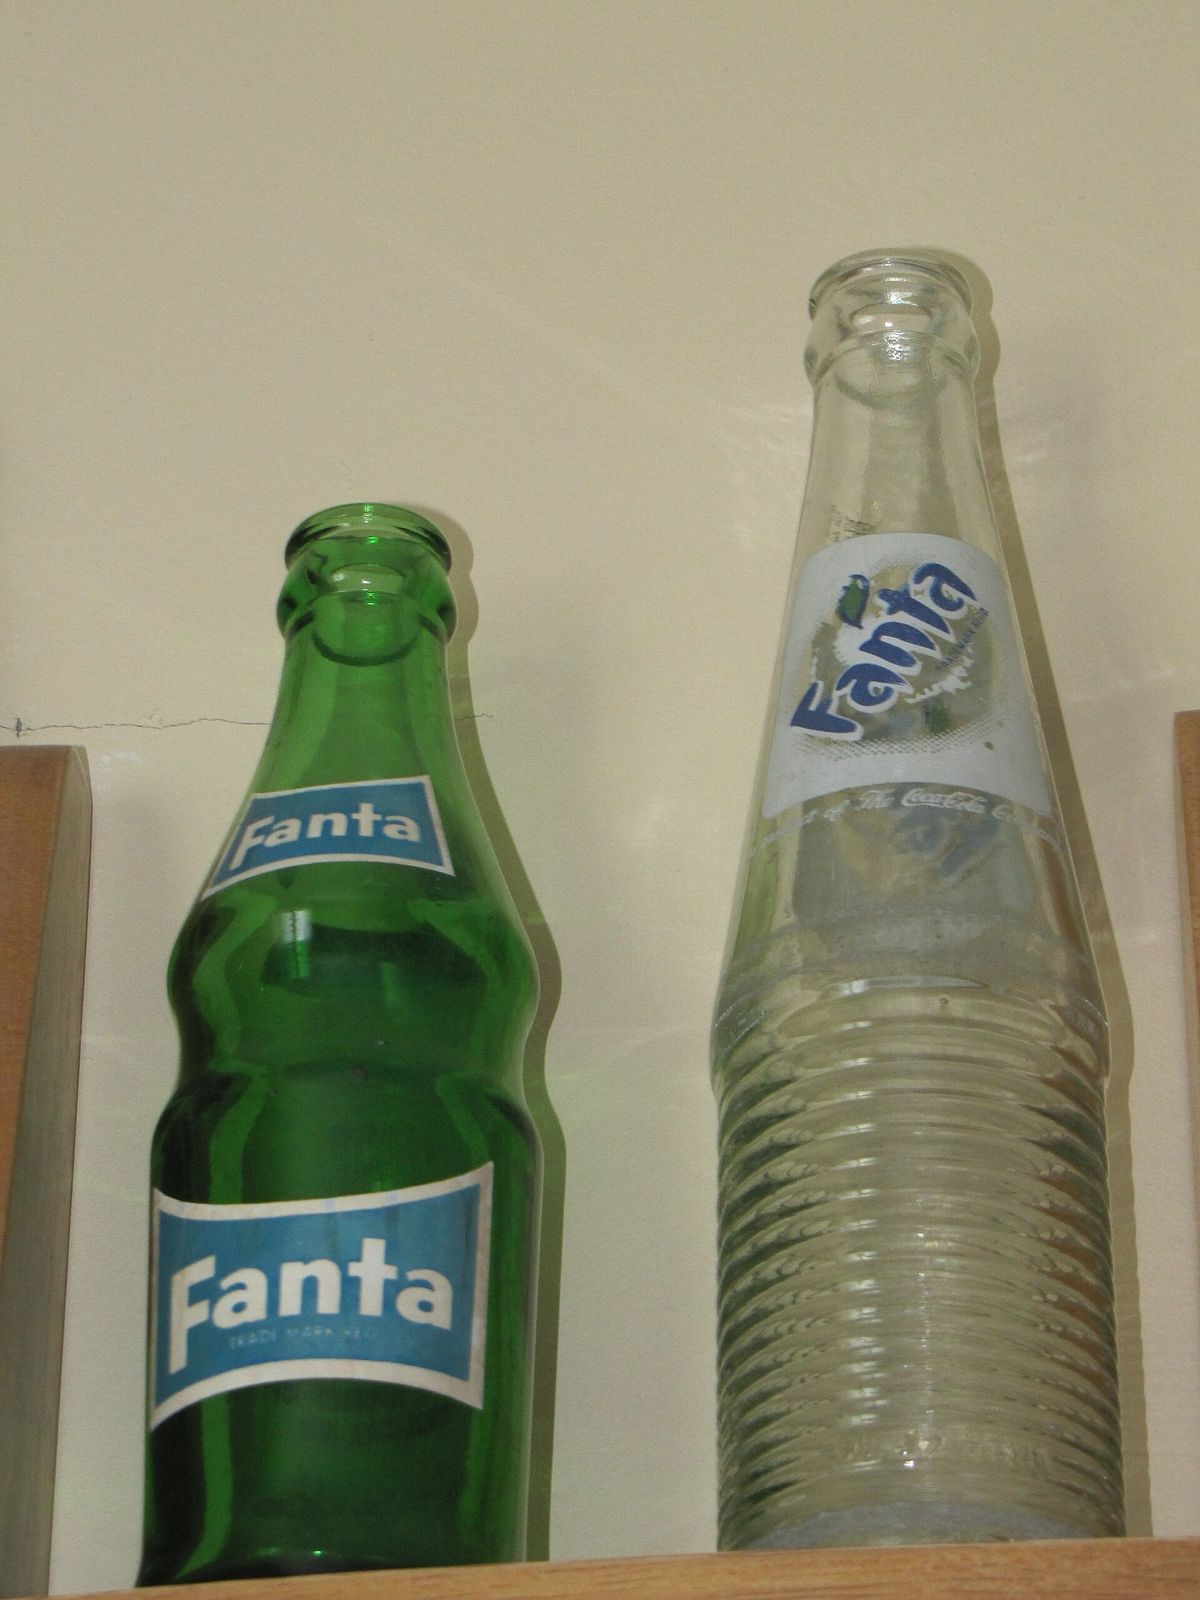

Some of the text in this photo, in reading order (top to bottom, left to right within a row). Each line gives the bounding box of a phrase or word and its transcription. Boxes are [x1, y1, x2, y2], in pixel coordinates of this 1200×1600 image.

[789, 561, 979, 737] Fanta
[229, 803, 421, 871] Fanta
[169, 1237, 453, 1375] Fanta
